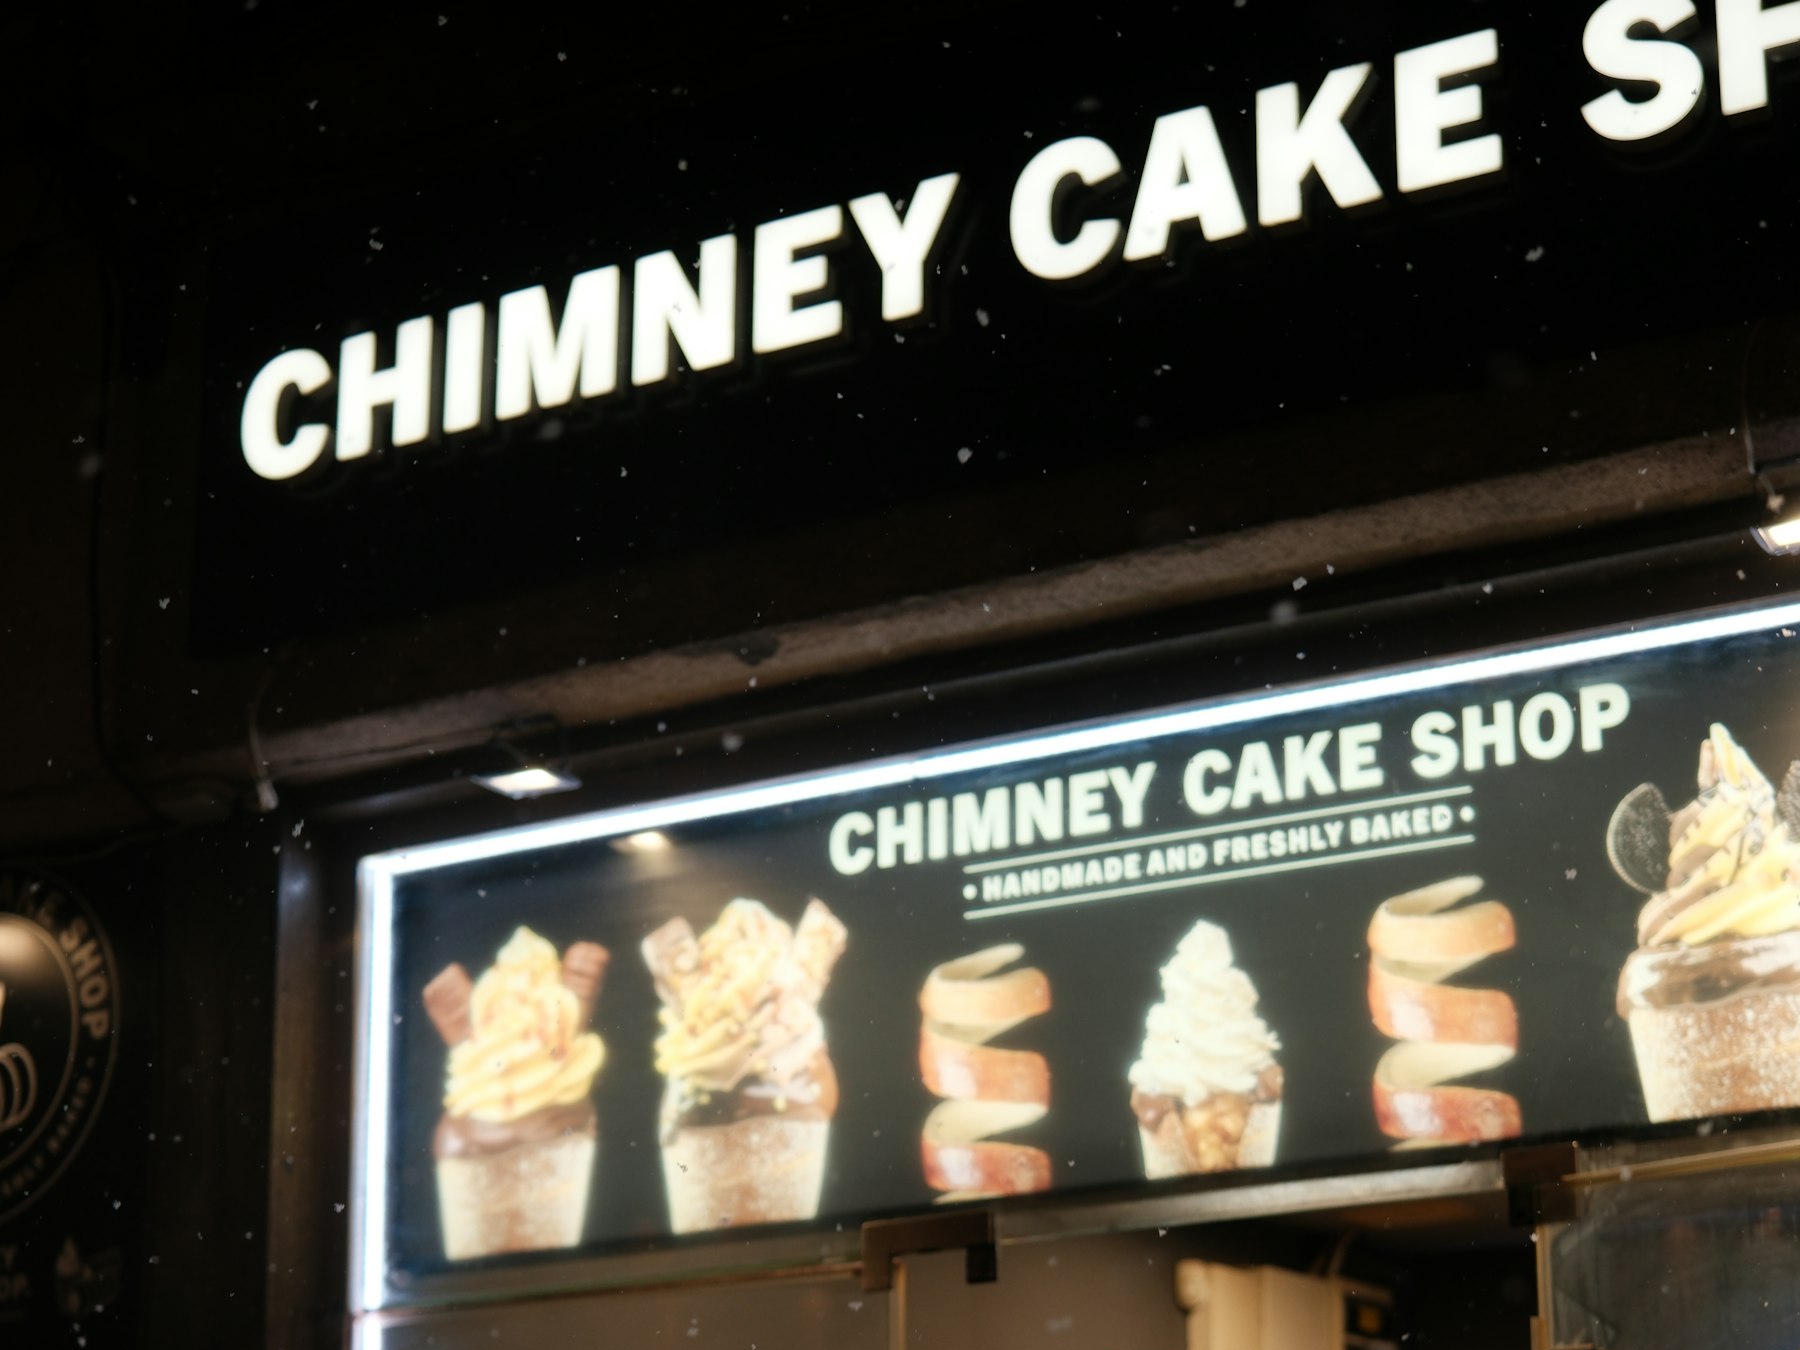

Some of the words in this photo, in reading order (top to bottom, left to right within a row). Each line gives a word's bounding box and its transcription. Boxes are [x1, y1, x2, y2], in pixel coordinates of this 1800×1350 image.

[241, 173, 959, 480] CHIMNEY
[1010, 28, 1503, 280] CAKE
[829, 761, 1157, 876] CHIMNEY
[1183, 722, 1385, 817] CAKE
[1410, 681, 1631, 780] SHOP
[982, 852, 1143, 902] HANDMADE
[1146, 841, 1208, 876] AND
[1212, 820, 1345, 867] FRESHLY
[1349, 804, 1454, 846] BAKED
[59, 916, 110, 1042] SHOP
